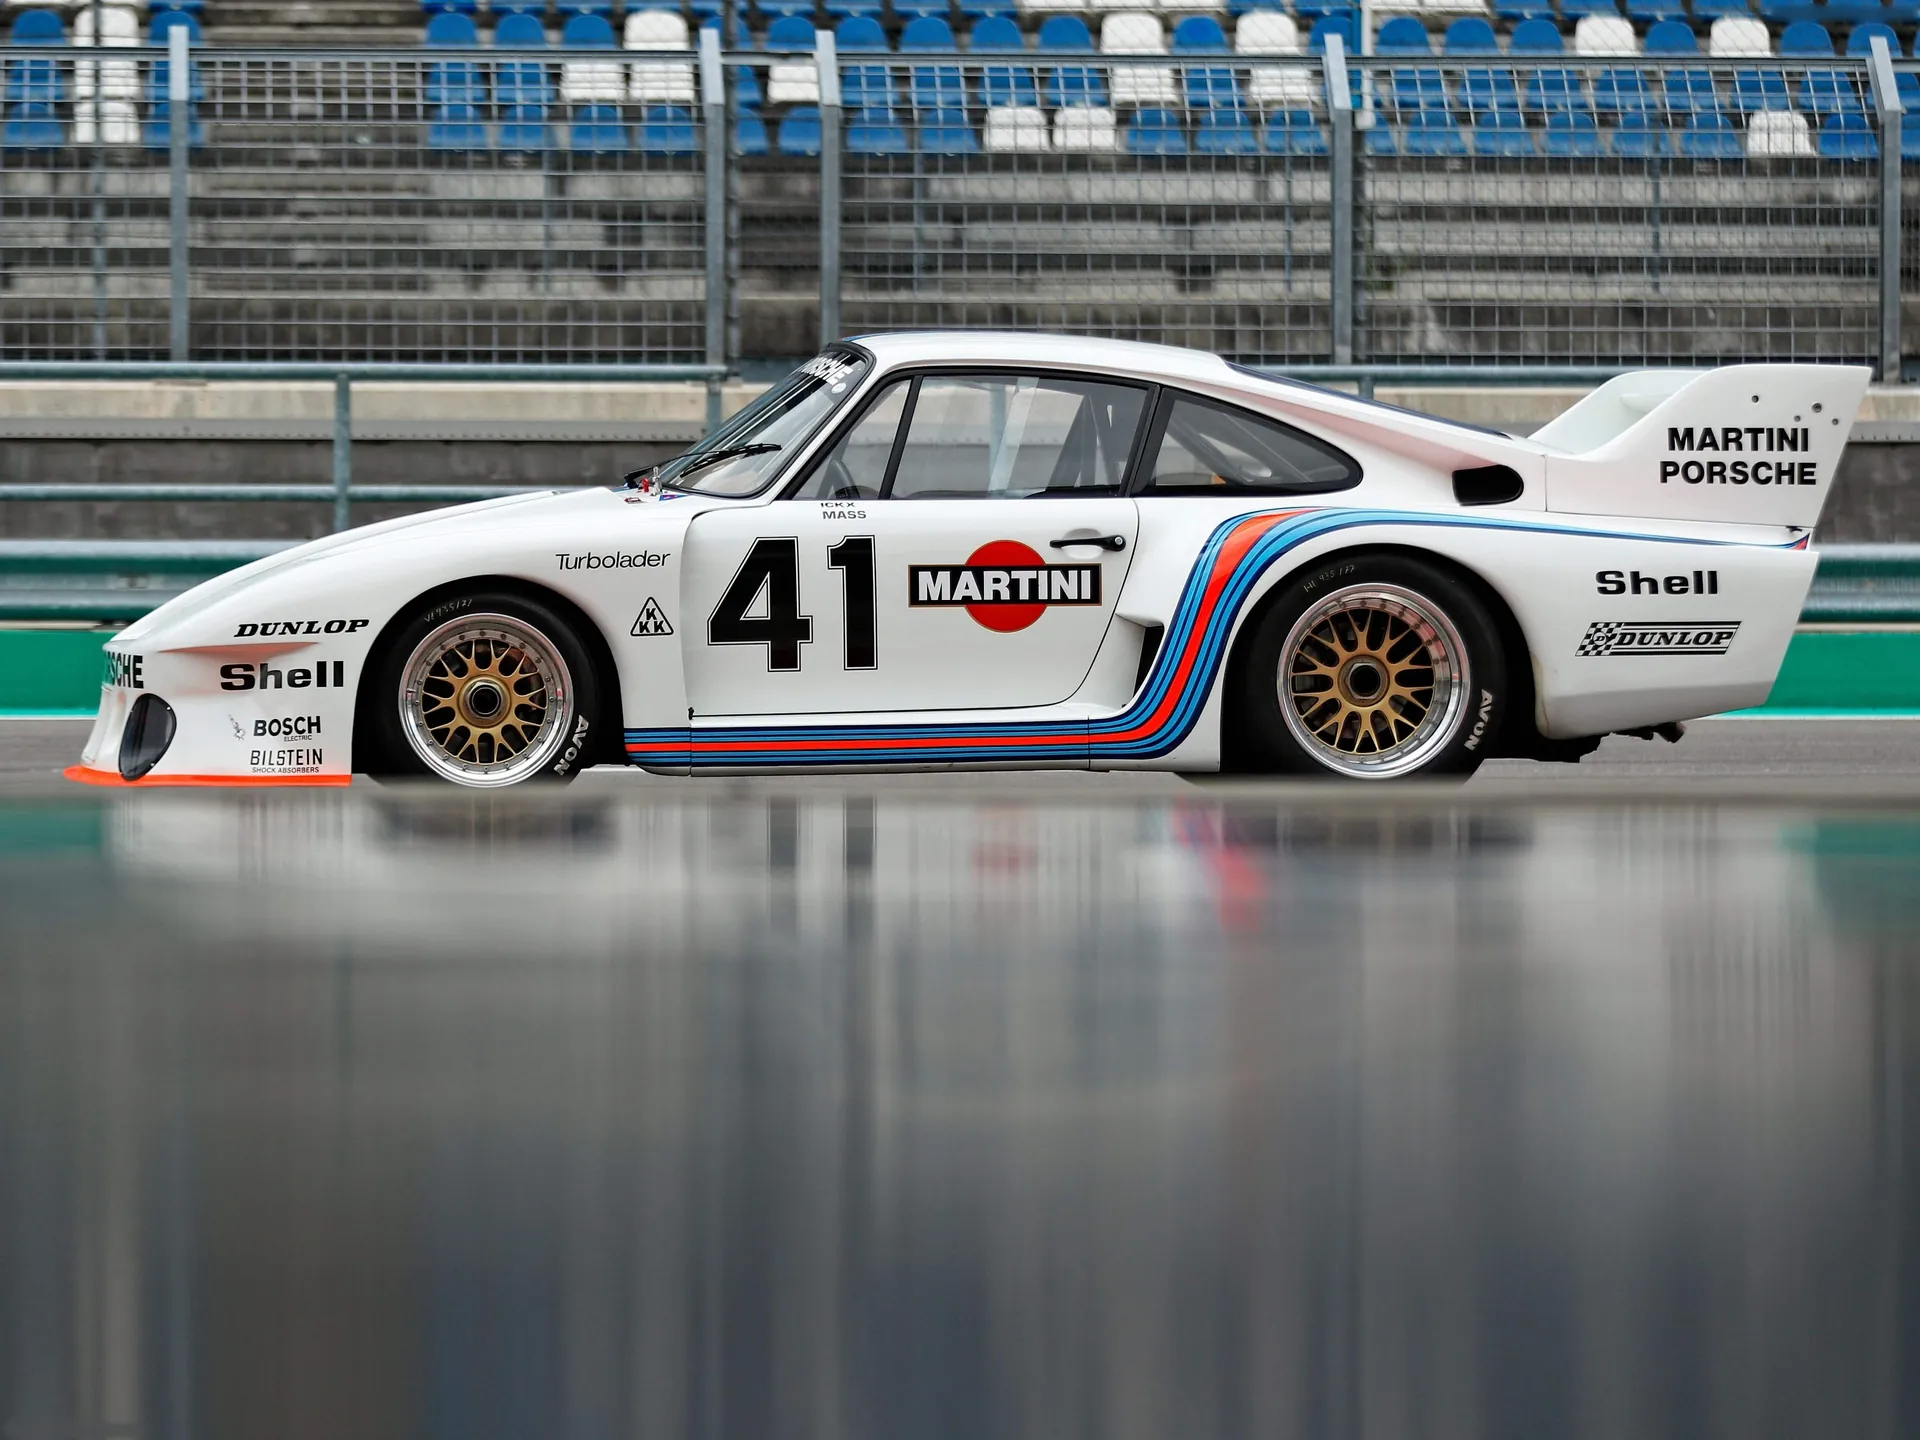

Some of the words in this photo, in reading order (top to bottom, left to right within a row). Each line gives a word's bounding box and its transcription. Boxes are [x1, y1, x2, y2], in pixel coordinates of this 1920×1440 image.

[1667, 427, 1809, 452] MARTINI
[1659, 461, 1817, 485] PORSCHE
[822, 510, 867, 519] MASS
[555, 550, 671, 570] Turbolader
[918, 569, 1092, 601] MARTINI
[1595, 570, 1719, 595] Shell
[707, 535, 878, 672] 41
[233, 619, 370, 637] DUNLOP
[1613, 632, 1735, 646] DUNLOP
[220, 661, 344, 691] Shell
[253, 716, 322, 736] BOSCH
[1463, 688, 1493, 751] AVON
[283, 734, 313, 742] ELECTRIC
[553, 714, 589, 776] AVON
[250, 748, 323, 766] BILSTEIN
[252, 766, 277, 774] SHOCK
[277, 766, 319, 774] ABSORBERS
